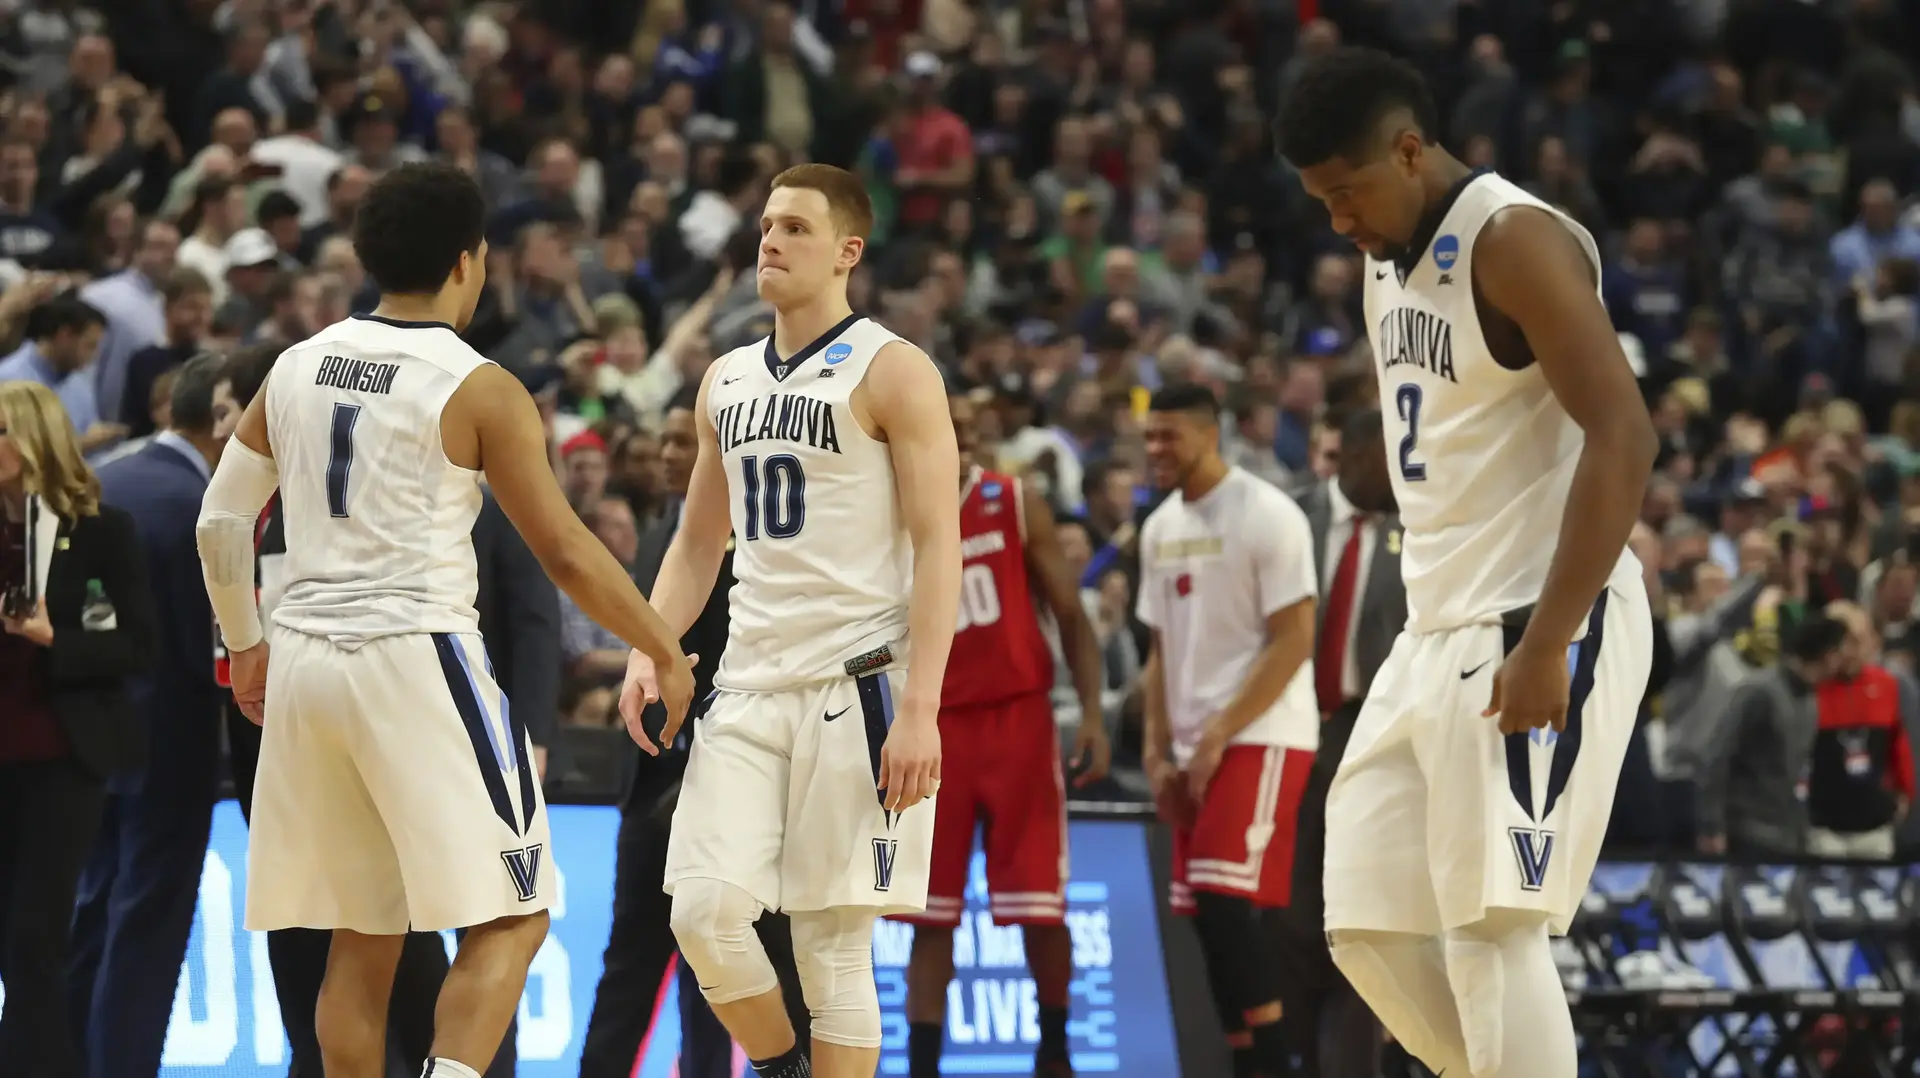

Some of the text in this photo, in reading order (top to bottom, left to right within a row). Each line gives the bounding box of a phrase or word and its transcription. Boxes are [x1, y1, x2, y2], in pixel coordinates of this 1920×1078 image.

[315, 355, 400, 395] BRUNSON
[326, 402, 361, 518] 1
[715, 393, 843, 461] VILLANOVA
[1396, 382, 1427, 482] 2
[741, 454, 805, 541] 10
[956, 564, 1002, 633] 0
[865, 646, 889, 660] NIKE
[500, 843, 542, 902] V
[872, 838, 898, 892] V
[1508, 826, 1556, 892] V
[947, 978, 1042, 1044] LIVE
